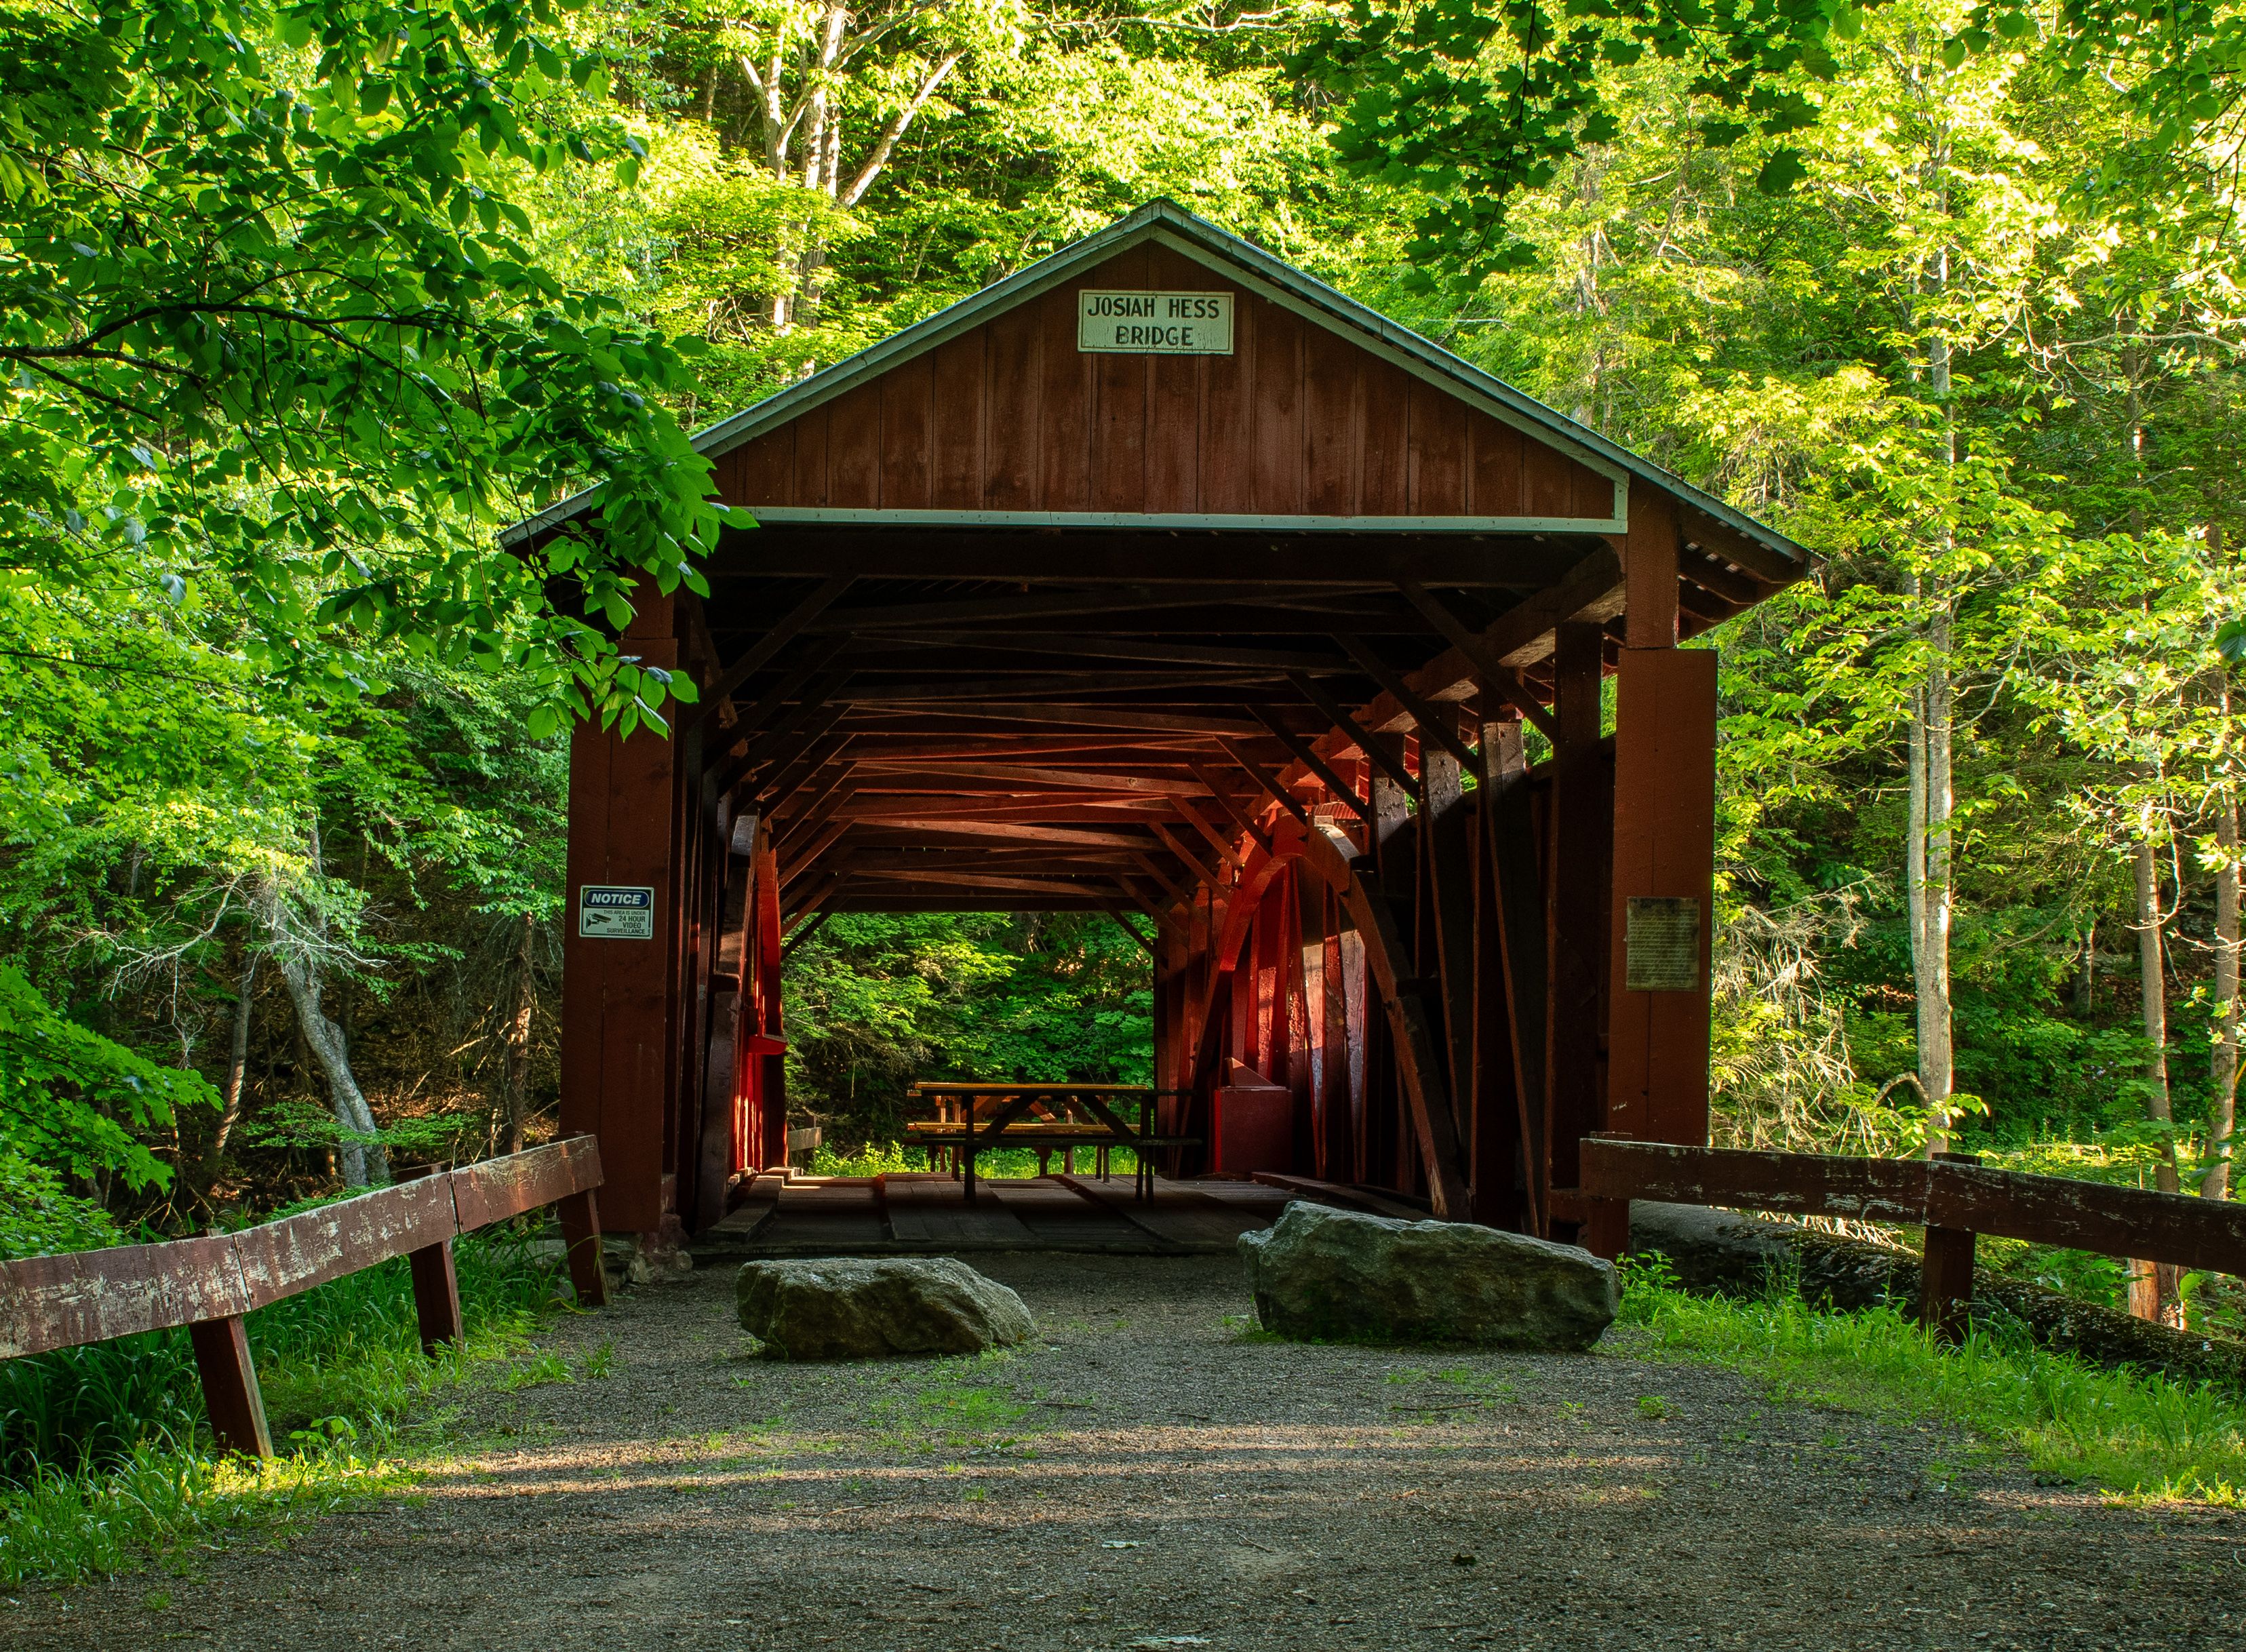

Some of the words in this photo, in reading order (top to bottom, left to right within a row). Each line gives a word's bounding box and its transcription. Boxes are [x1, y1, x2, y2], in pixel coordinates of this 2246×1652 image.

[1087, 296, 1155, 317] JOSIAH
[1168, 298, 1219, 319] HESS
[1116, 326, 1194, 346] BRIDGE
[591, 893, 642, 905] NOTICE
